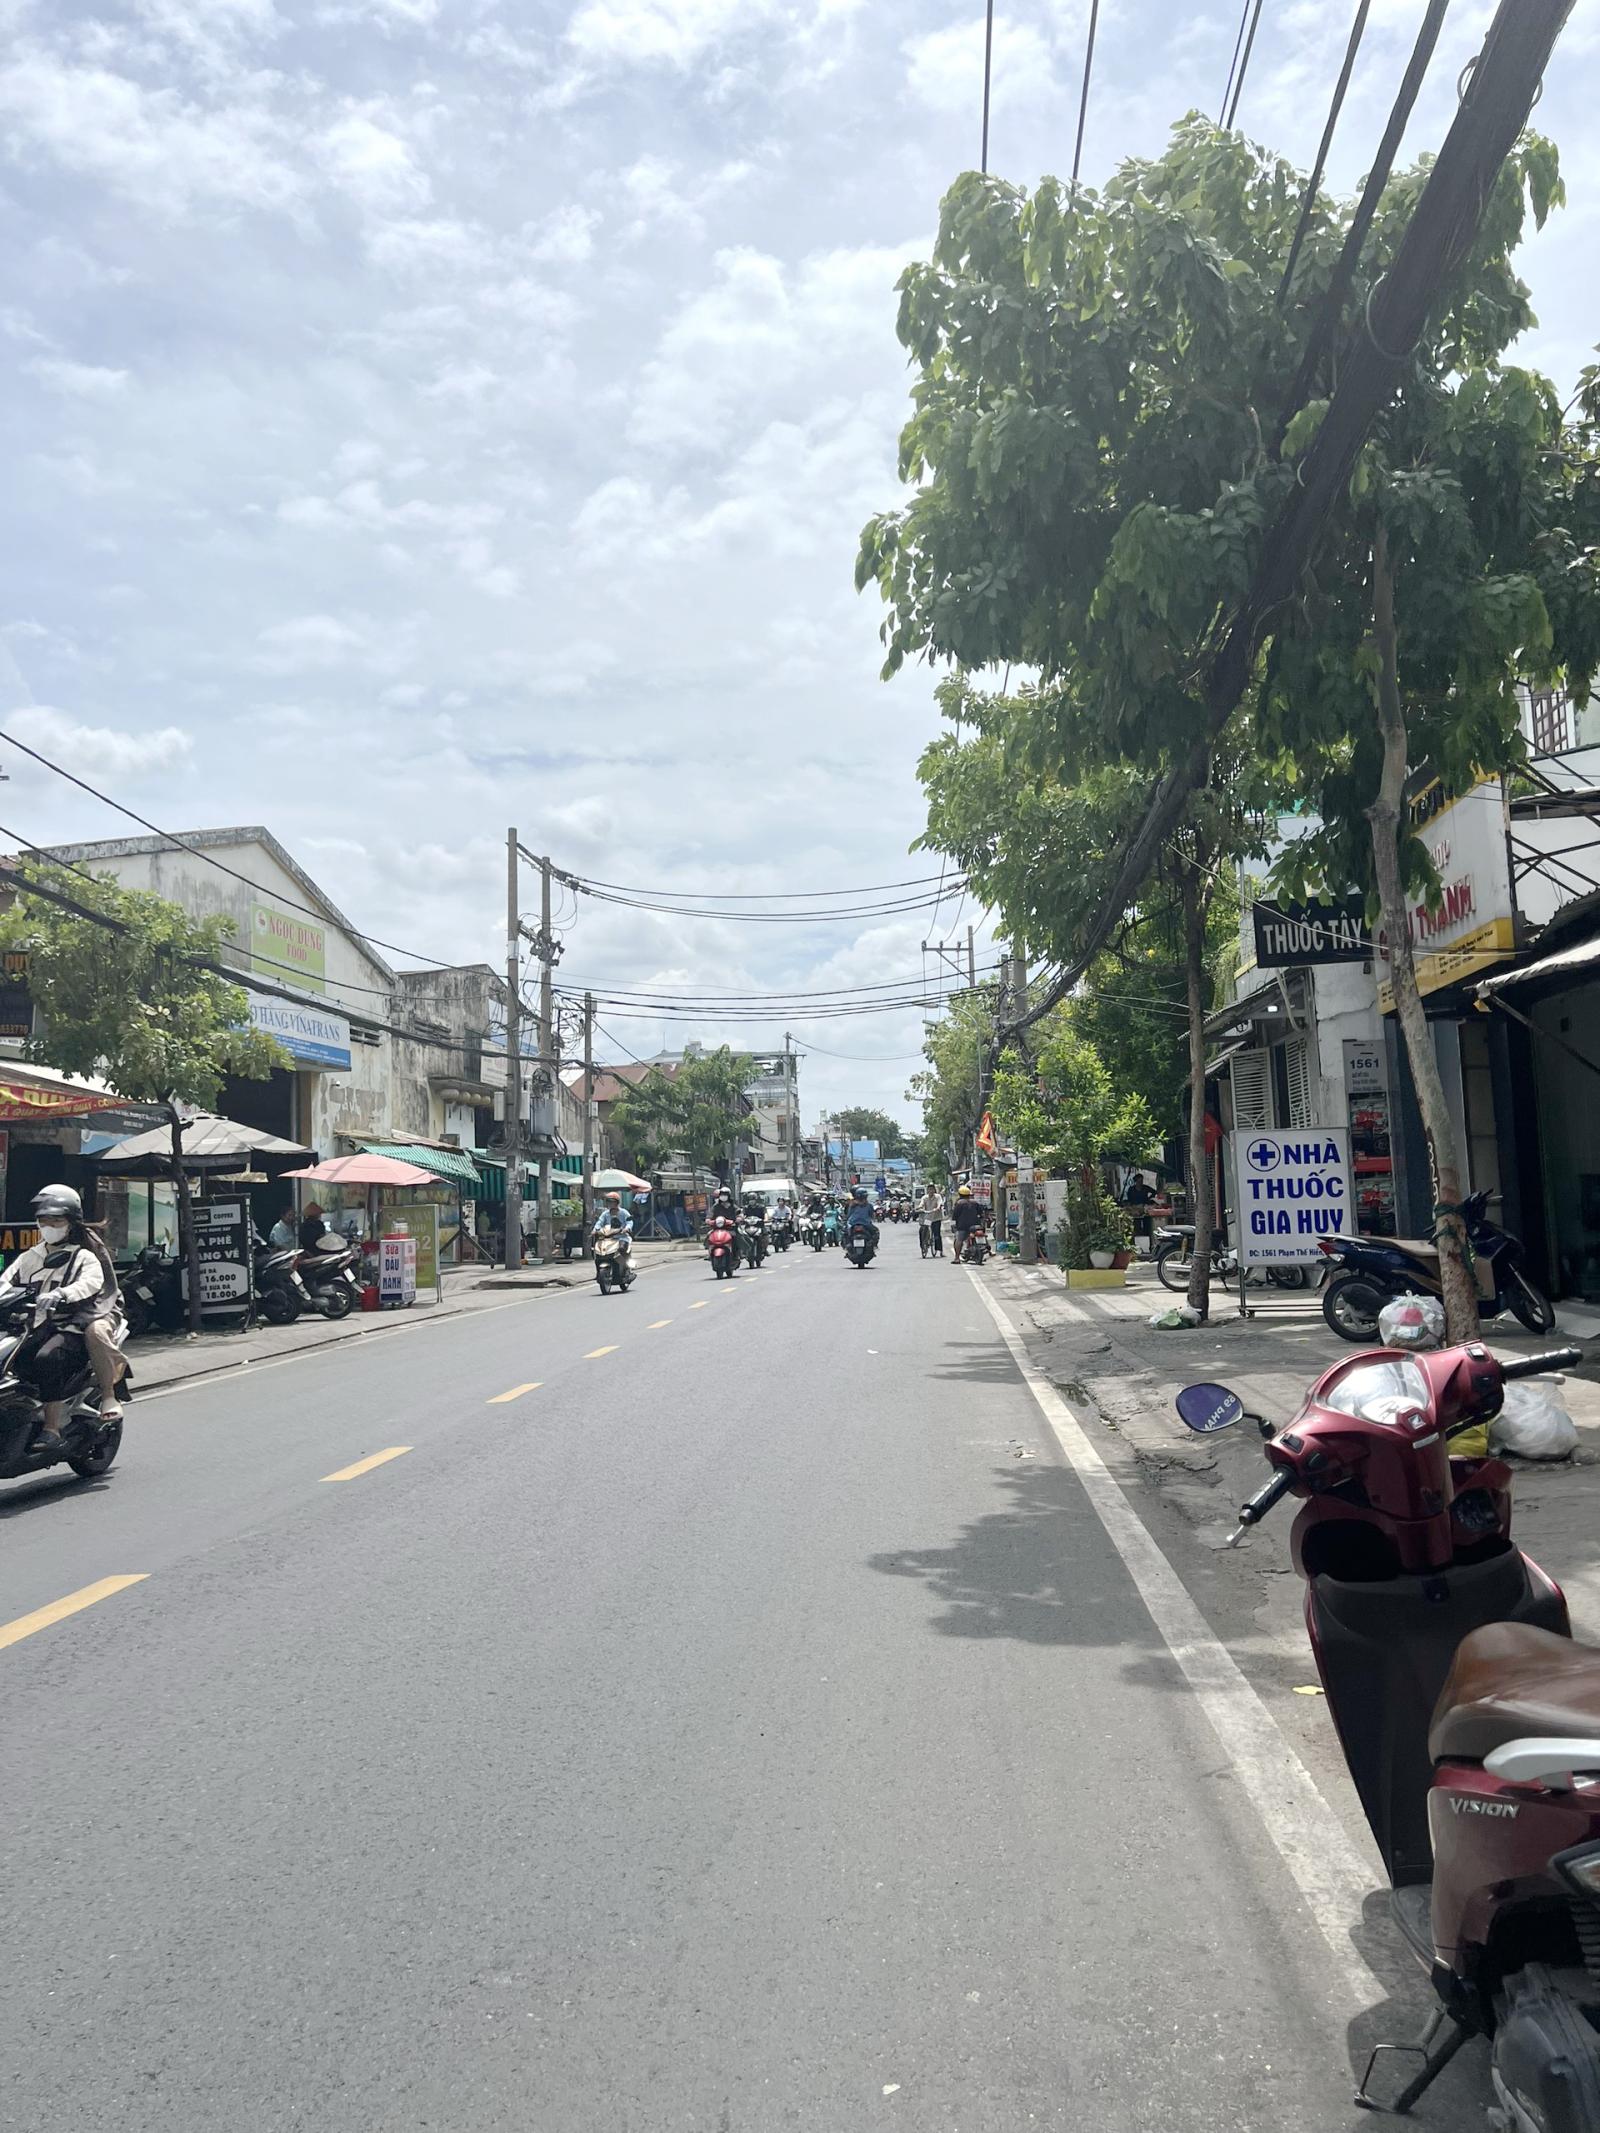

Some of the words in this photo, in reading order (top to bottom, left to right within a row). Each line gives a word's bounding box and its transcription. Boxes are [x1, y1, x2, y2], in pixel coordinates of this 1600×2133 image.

[1262, 909, 1324, 954] THUỐC
[1328, 911, 1362, 950] TÂY
[1350, 1058, 1379, 1069] 1561
[1283, 1137, 1341, 1165] NHÀ
[1247, 1169, 1344, 1199] THUỐC
[1251, 1210, 1291, 1235] GIA
[1297, 1209, 1343, 1233] HUY
[1262, 1249, 1277, 1257] 1561
[205, 1274, 236, 1282] 16.000
[206, 1290, 237, 1299] 18.000
[1449, 1798, 1520, 1818] VISION
